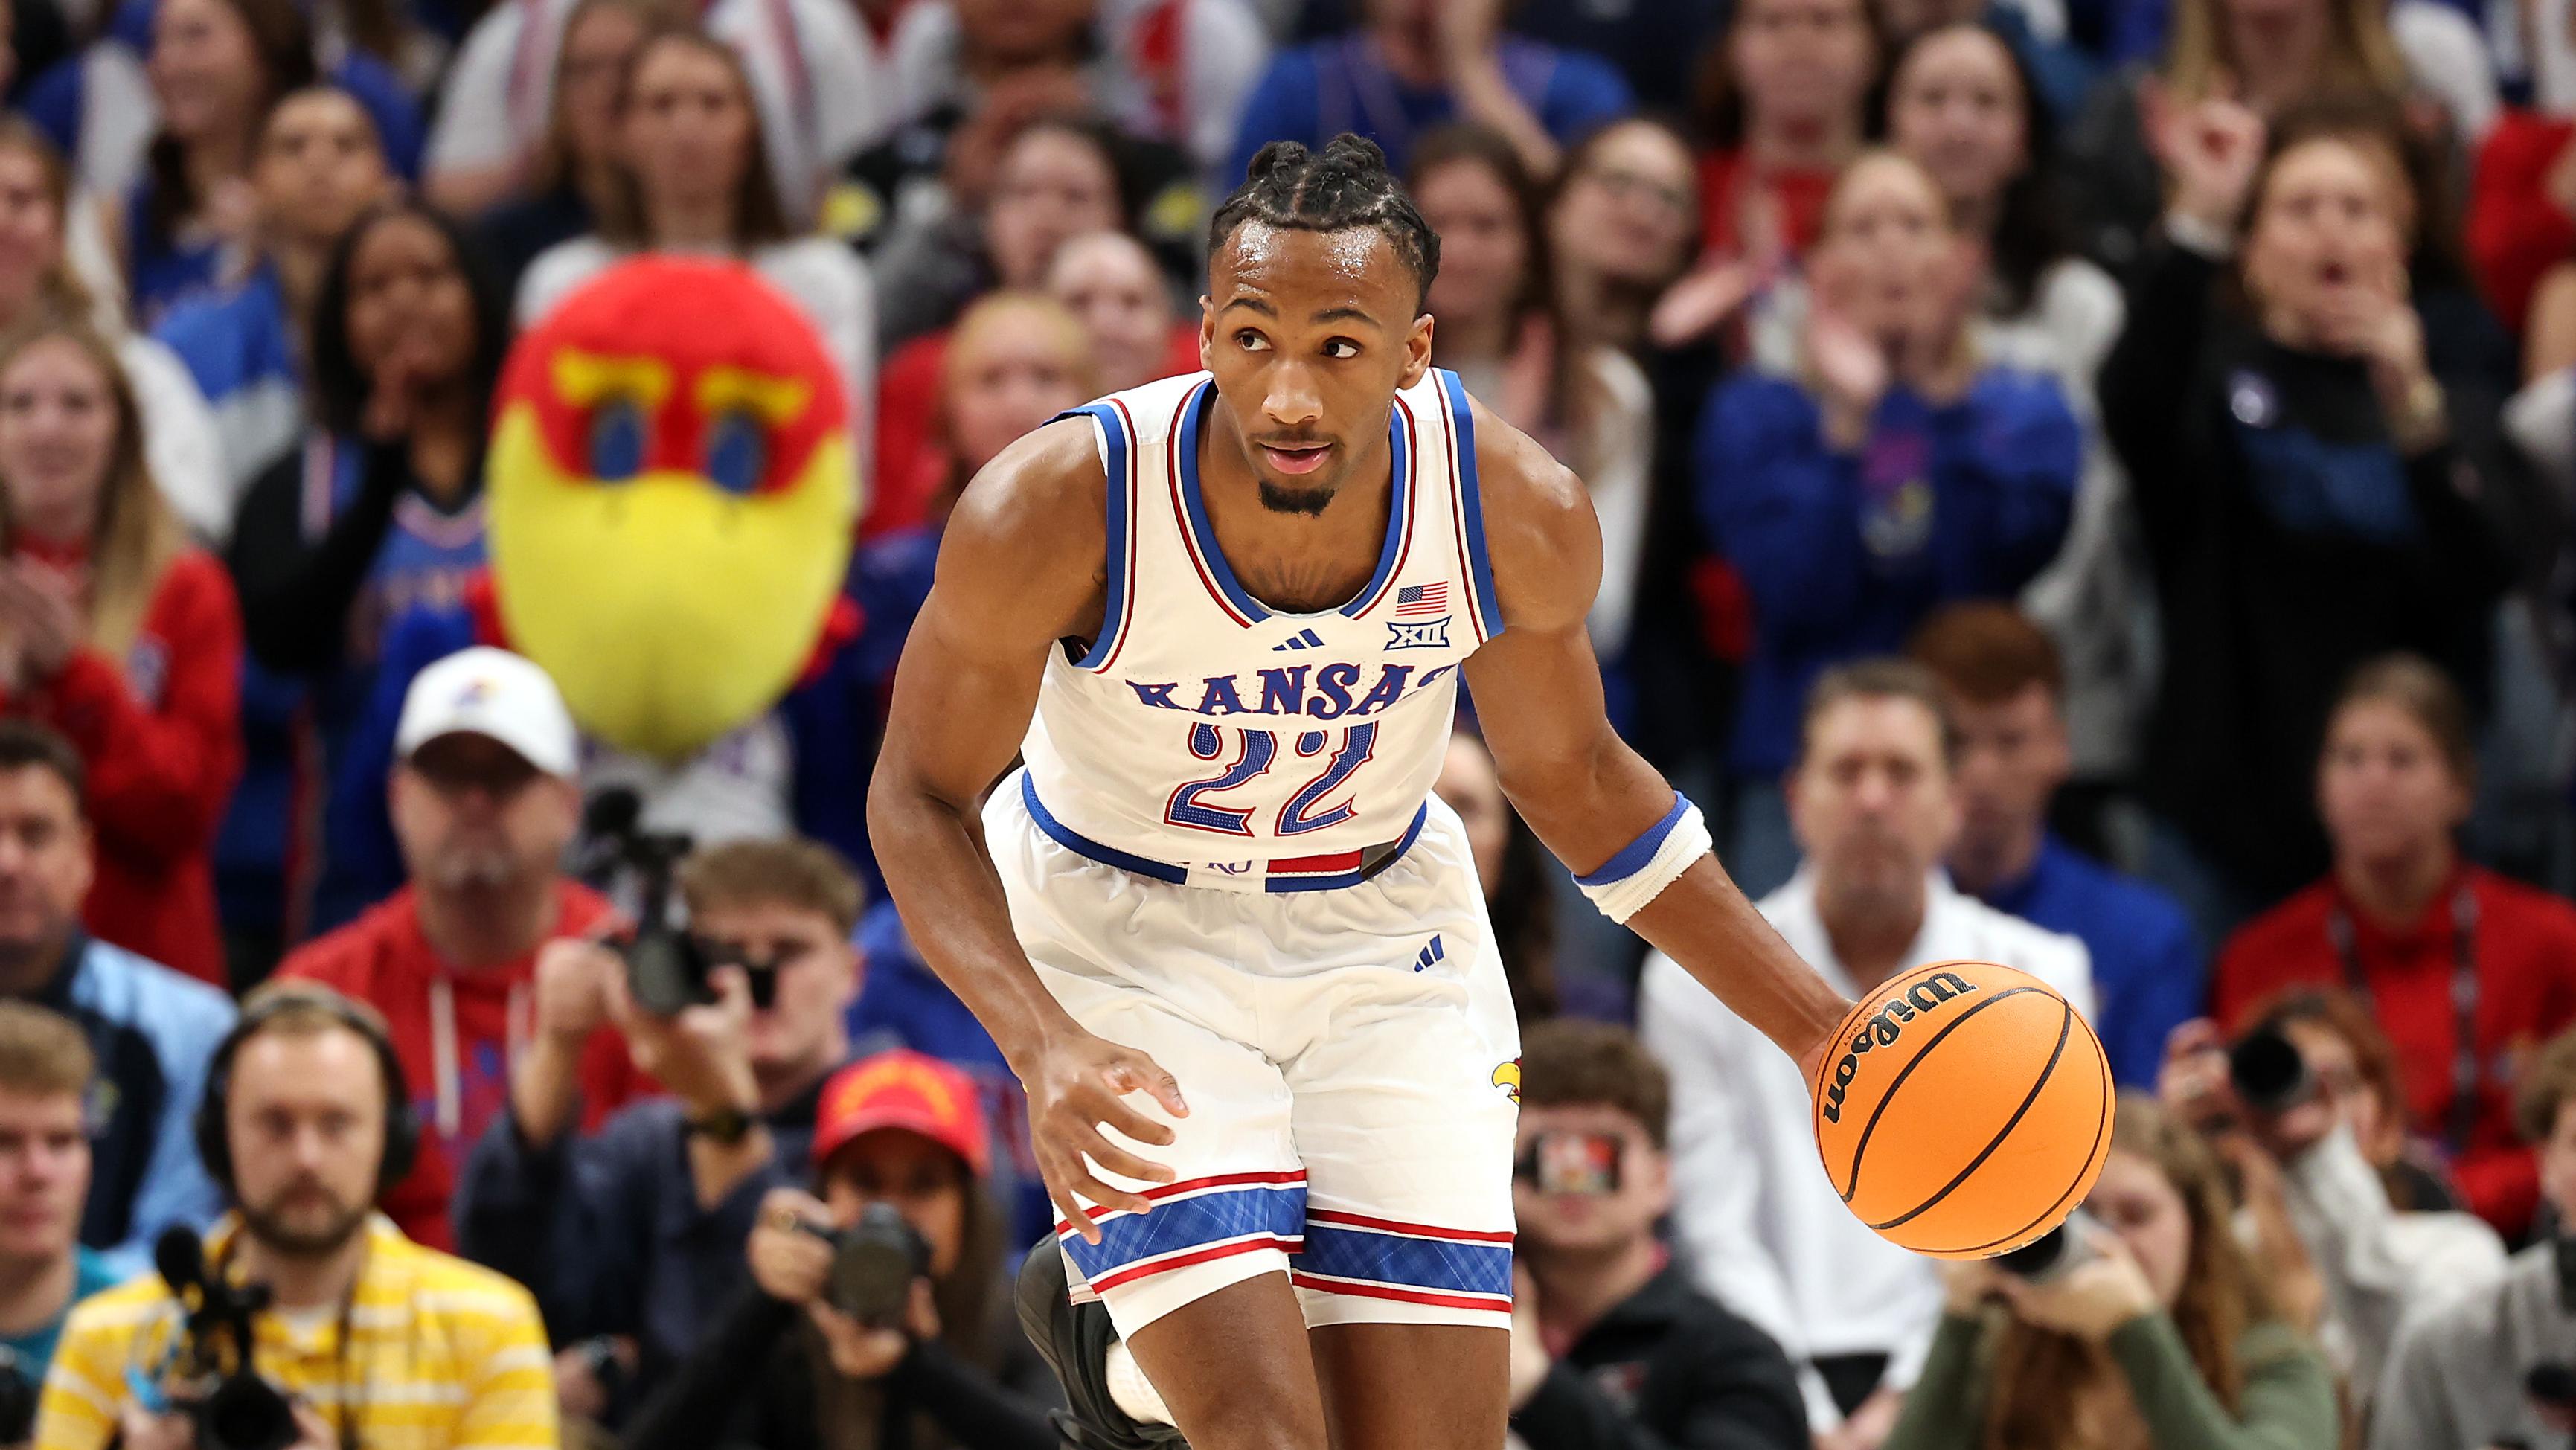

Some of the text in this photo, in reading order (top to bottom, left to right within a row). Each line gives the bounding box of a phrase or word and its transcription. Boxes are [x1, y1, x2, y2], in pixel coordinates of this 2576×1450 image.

[1384, 615, 1452, 650] XII
[1164, 720, 1379, 838] 22
[1823, 972, 1978, 1124] Wilson
